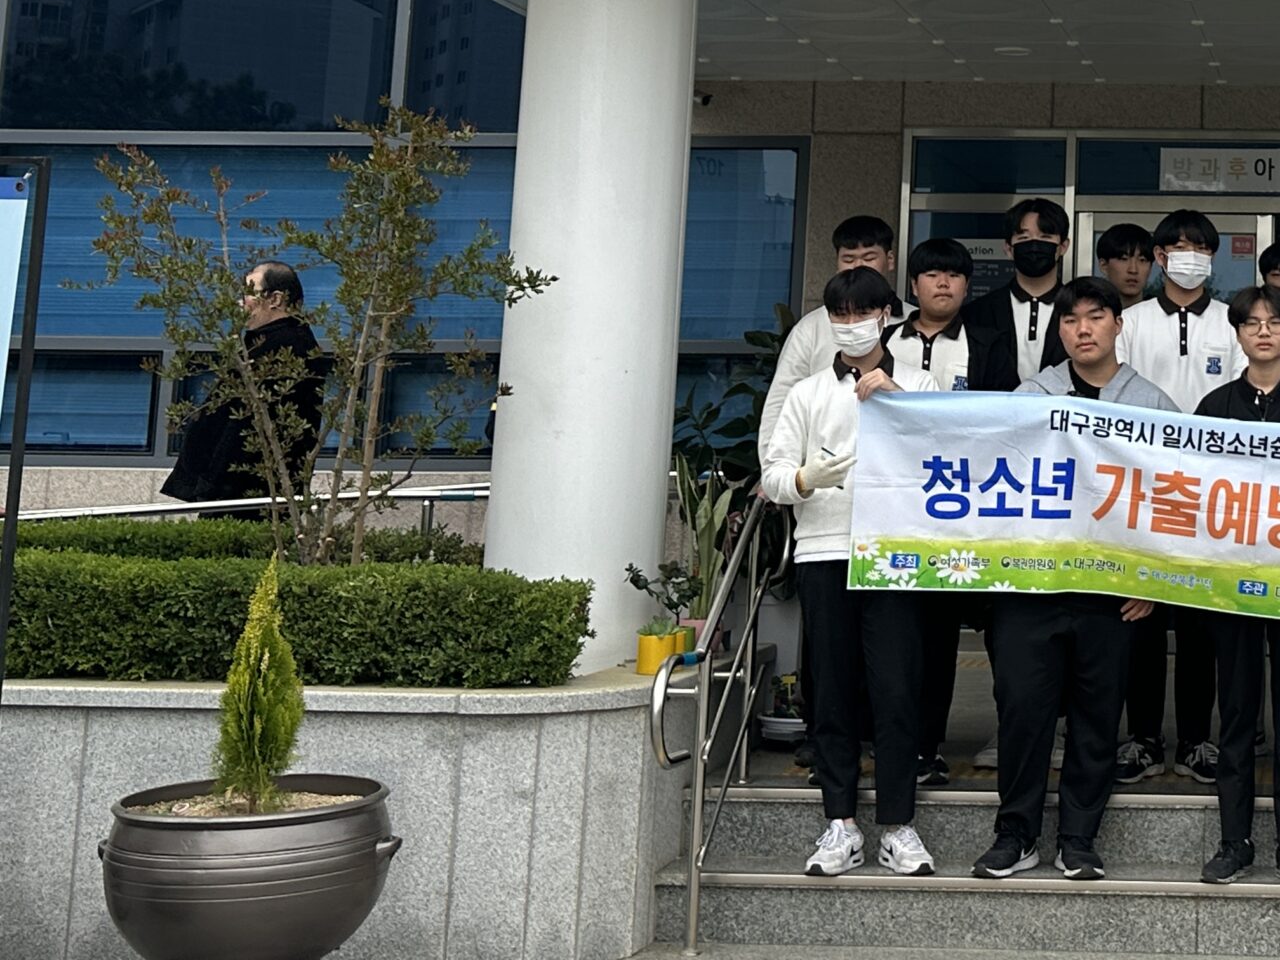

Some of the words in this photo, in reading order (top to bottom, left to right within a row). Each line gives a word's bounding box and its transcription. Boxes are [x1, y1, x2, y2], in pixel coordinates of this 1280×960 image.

[1050, 409, 1155, 445] 대구광역시
[922, 455, 1076, 521] 청소년
[895, 555, 918, 569] 주최
[940, 555, 991, 569] 여성가족부
[1074, 557, 1127, 575] 대구광역시
[1241, 581, 1265, 596] 주관
